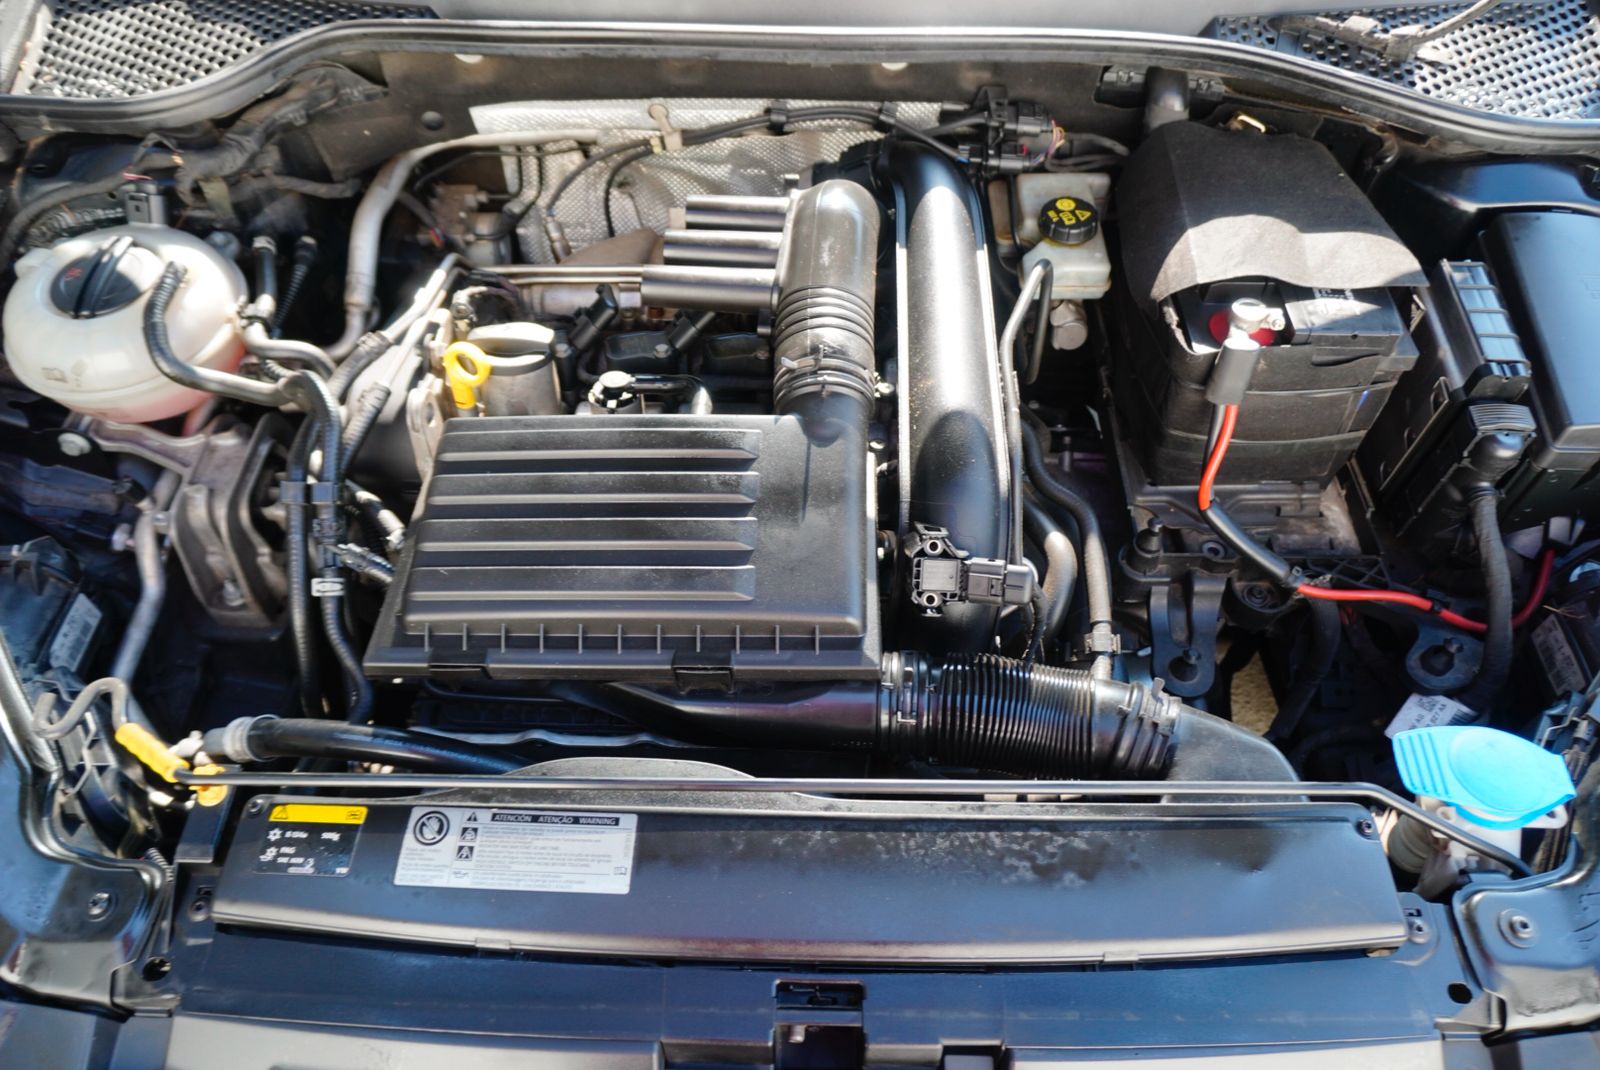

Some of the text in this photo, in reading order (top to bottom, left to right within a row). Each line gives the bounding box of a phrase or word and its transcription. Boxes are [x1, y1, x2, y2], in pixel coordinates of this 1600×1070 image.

[494, 814, 616, 826] ATENCIÓN ATENÇÃO WARNING
